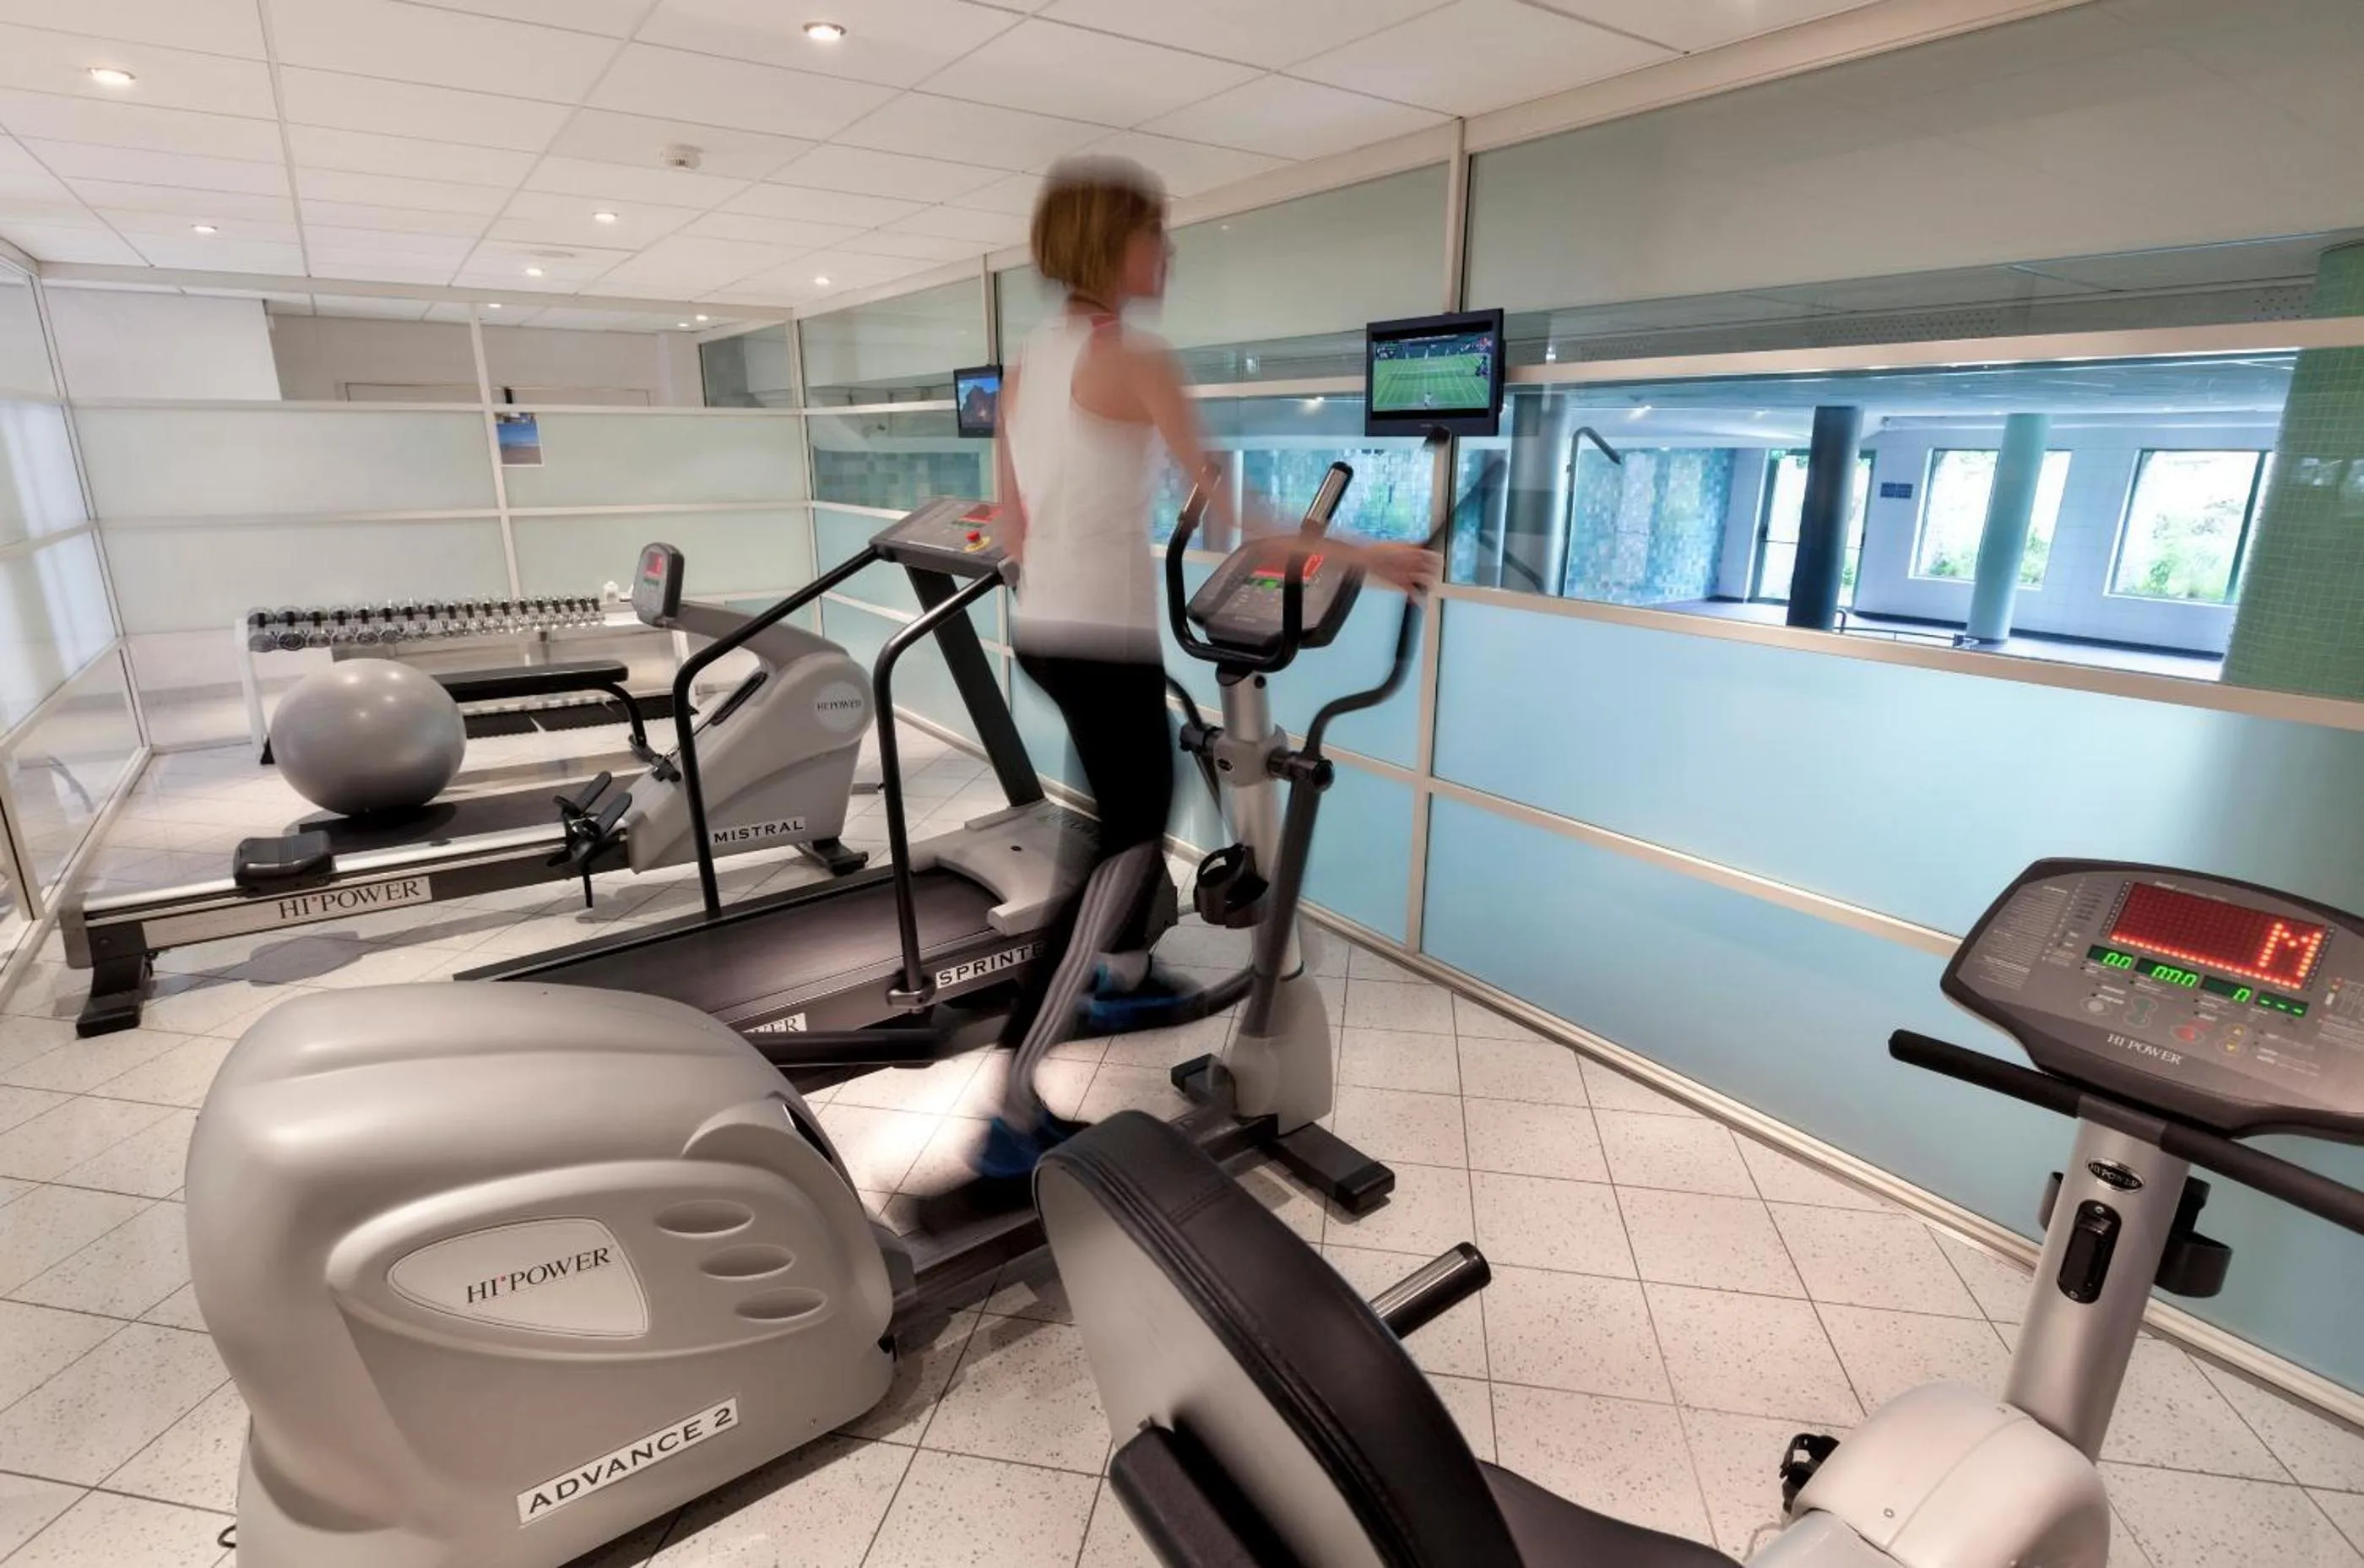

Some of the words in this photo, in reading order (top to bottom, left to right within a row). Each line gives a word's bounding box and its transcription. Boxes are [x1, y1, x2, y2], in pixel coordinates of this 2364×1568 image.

[713, 820, 805, 843] MISTRAL
[529, 1419, 703, 1514] ADVANCE
[713, 1407, 733, 1428] 2
